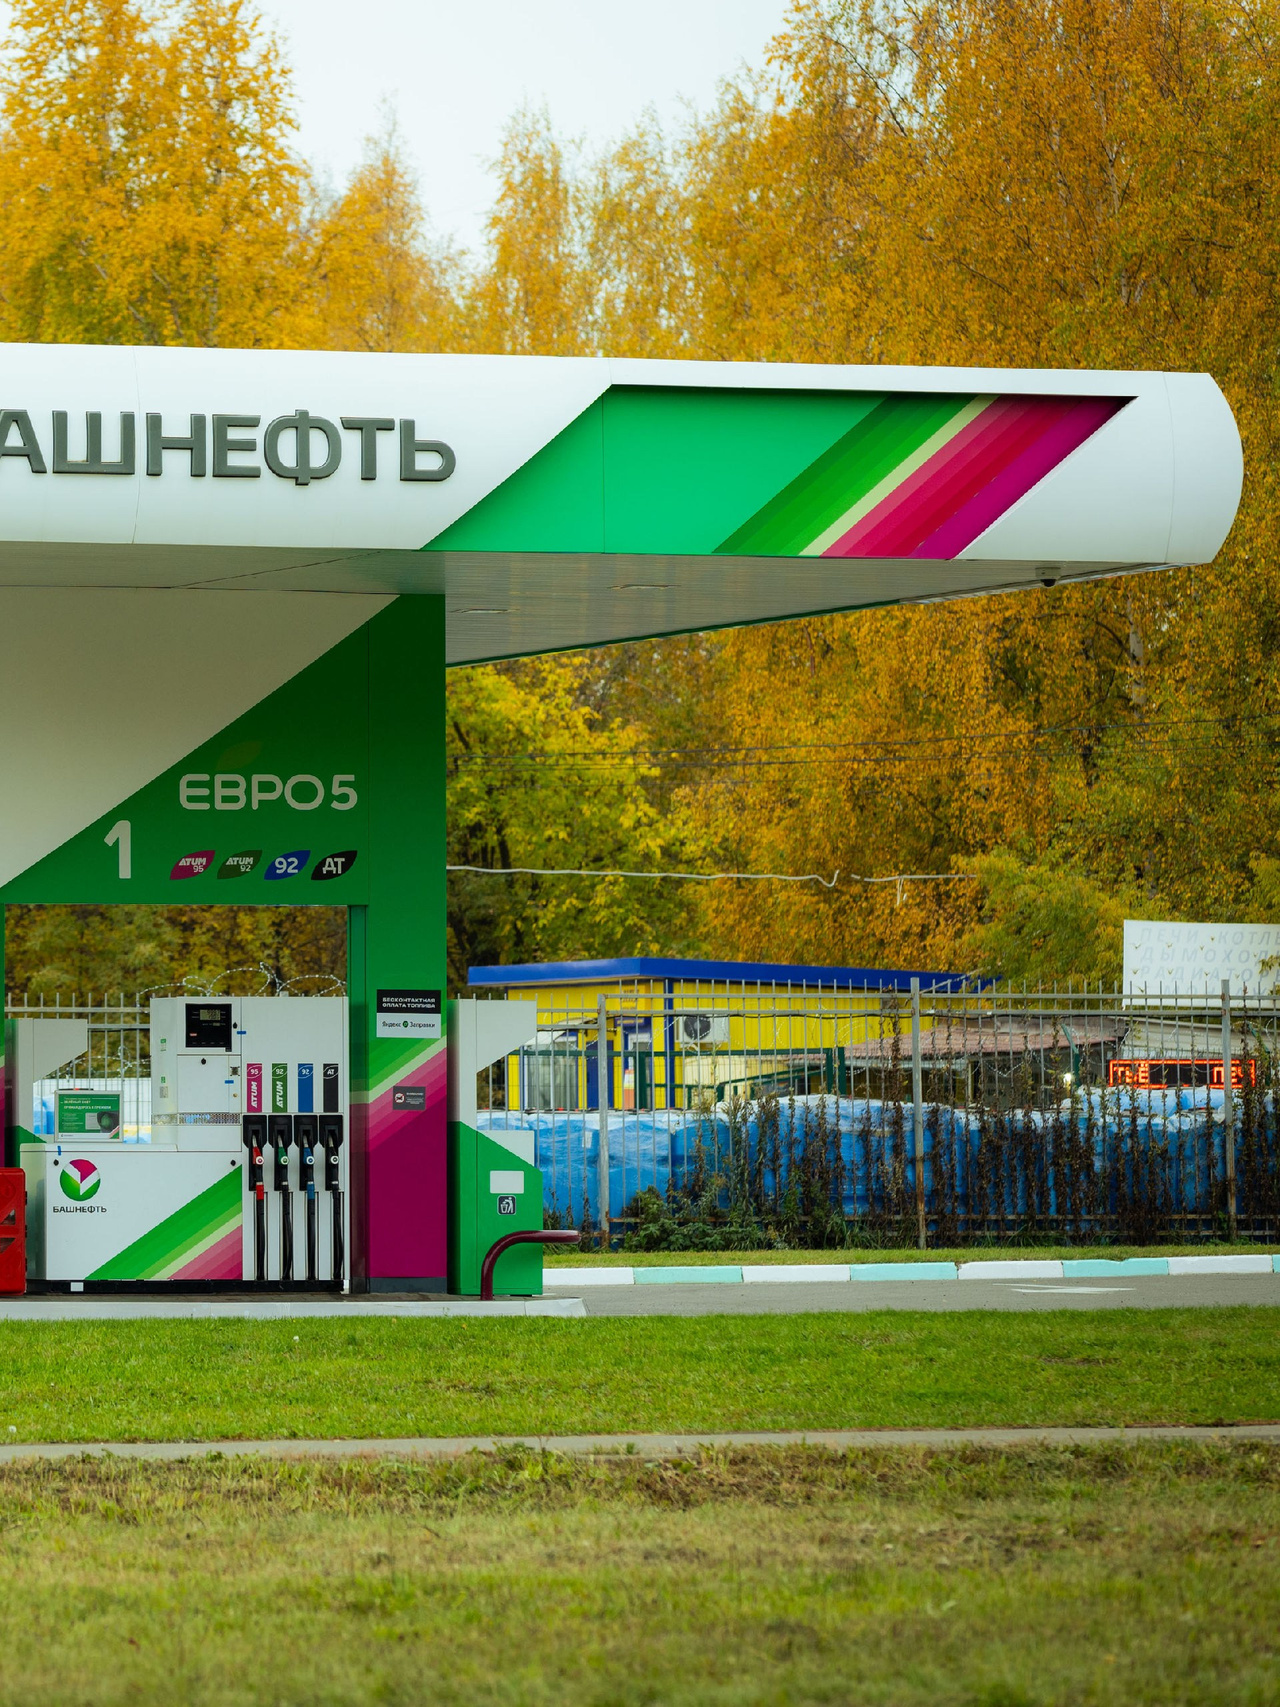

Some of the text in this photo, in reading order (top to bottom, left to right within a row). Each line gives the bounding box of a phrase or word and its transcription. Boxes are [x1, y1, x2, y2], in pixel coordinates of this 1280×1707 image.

[104, 820, 132, 880] 1
[178, 857, 207, 867] ATUM
[192, 865, 205, 873] 95
[225, 856, 254, 866] ATUM
[274, 857, 299, 875] 92
[322, 857, 346, 875] ДТ
[1140, 927, 1199, 943] ПЕЧИ
[250, 1081, 258, 1109] ATUM
[276, 1080, 284, 1109] ATUM
[52, 1205, 108, 1214] БАШНЕФТЬ
